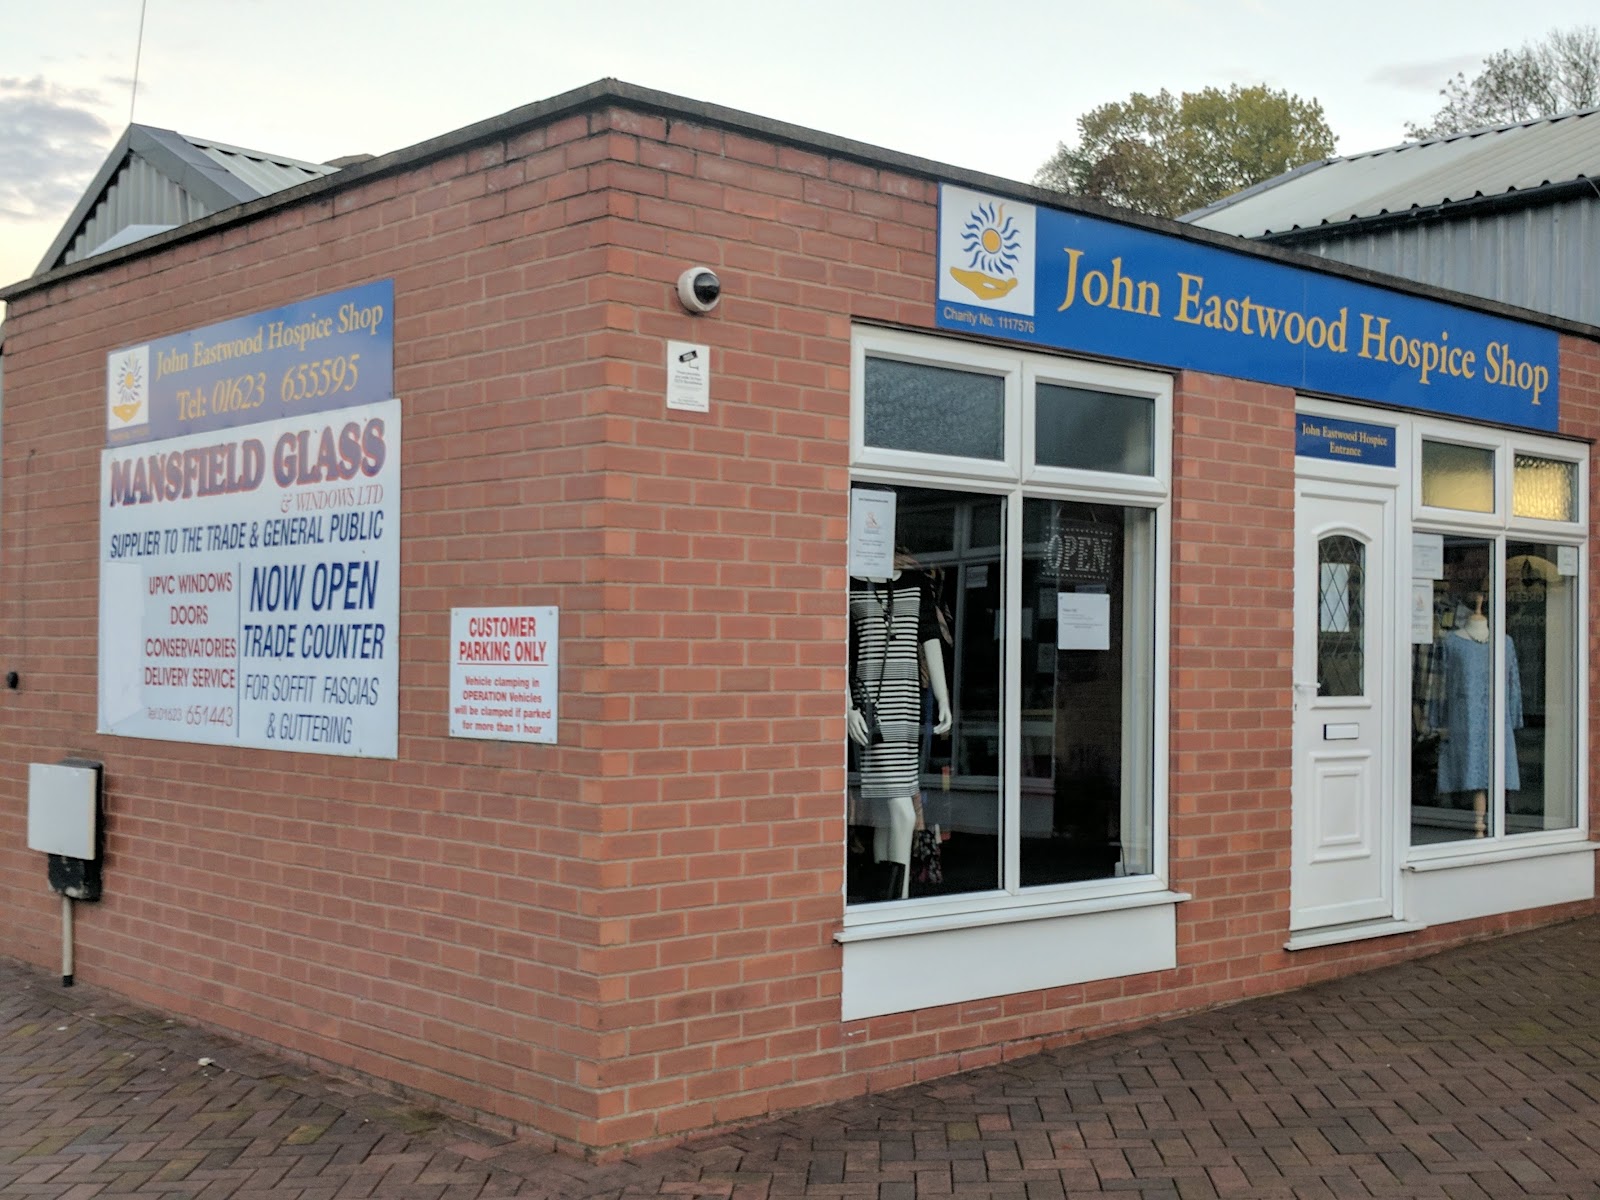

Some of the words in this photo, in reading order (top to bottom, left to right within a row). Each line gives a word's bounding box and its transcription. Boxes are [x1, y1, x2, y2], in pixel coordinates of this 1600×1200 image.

[943, 306, 977, 326] Charity
[980, 313, 995, 327] No.
[998, 316, 1035, 333] 1117576
[1057, 248, 1161, 318] John
[1174, 272, 1348, 353] Eastwood
[1358, 313, 1475, 385] Hospice
[1484, 341, 1548, 405] Shop
[156, 351, 188, 381] John
[192, 327, 263, 368] Eastwood
[268, 313, 332, 351] Hospice
[338, 303, 383, 335] Shop
[176, 387, 207, 421] Tel:
[212, 372, 267, 415] 01623
[281, 354, 360, 401] 655595
[1302, 422, 1320, 436] John
[1323, 426, 1357, 442] Eastwood
[1359, 431, 1387, 448] Hospice
[1330, 441, 1361, 456] Entrance
[110, 438, 265, 508] MANSFIELD
[273, 417, 386, 488] GLASS
[280, 494, 293, 513] &
[295, 489, 355, 512] WINDOWS
[357, 484, 383, 506] LTD
[110, 530, 160, 558] SUPPLIER
[164, 528, 179, 555] TO
[182, 526, 203, 553] THE
[207, 522, 247, 550] TRADE
[249, 521, 258, 548] &
[263, 517, 325, 547] GENERAL
[329, 510, 384, 542] PUBLIC
[1047, 534, 1109, 573] OPEN
[149, 574, 176, 595] UPVC
[178, 572, 233, 593] WINDOWS
[249, 564, 306, 612] NOW
[311, 560, 380, 611] OPEN
[170, 605, 208, 625] DOORS
[469, 617, 537, 638] CUSTOMER
[145, 638, 236, 659] CONSERVATORIES
[243, 624, 297, 658] TRADE
[301, 623, 386, 659] COUNTER
[459, 641, 511, 662] PARKING
[515, 641, 547, 662] ONLY
[144, 667, 191, 687] DELIVERY
[192, 668, 236, 689] SERVICE
[245, 674, 270, 701] FOR
[272, 674, 317, 703] SOFFIT
[322, 676, 380, 706] FASCIAS
[465, 676, 492, 686] Vehicle
[494, 677, 530, 689] clamping
[532, 678, 540, 687] in
[463, 690, 507, 702] OPERATION
[509, 692, 542, 703] Vehicles
[187, 705, 233, 727] 651443
[455, 705, 467, 715] will
[469, 706, 478, 715] be
[481, 706, 513, 717] clamped
[515, 708, 521, 717] if
[523, 709, 551, 720] parked
[266, 712, 275, 739] &
[280, 713, 353, 745] GUTTERING
[463, 720, 472, 730] for
[475, 722, 494, 731] more
[497, 722, 513, 732] than
[516, 724, 521, 733] 1
[524, 724, 542, 734] hour
